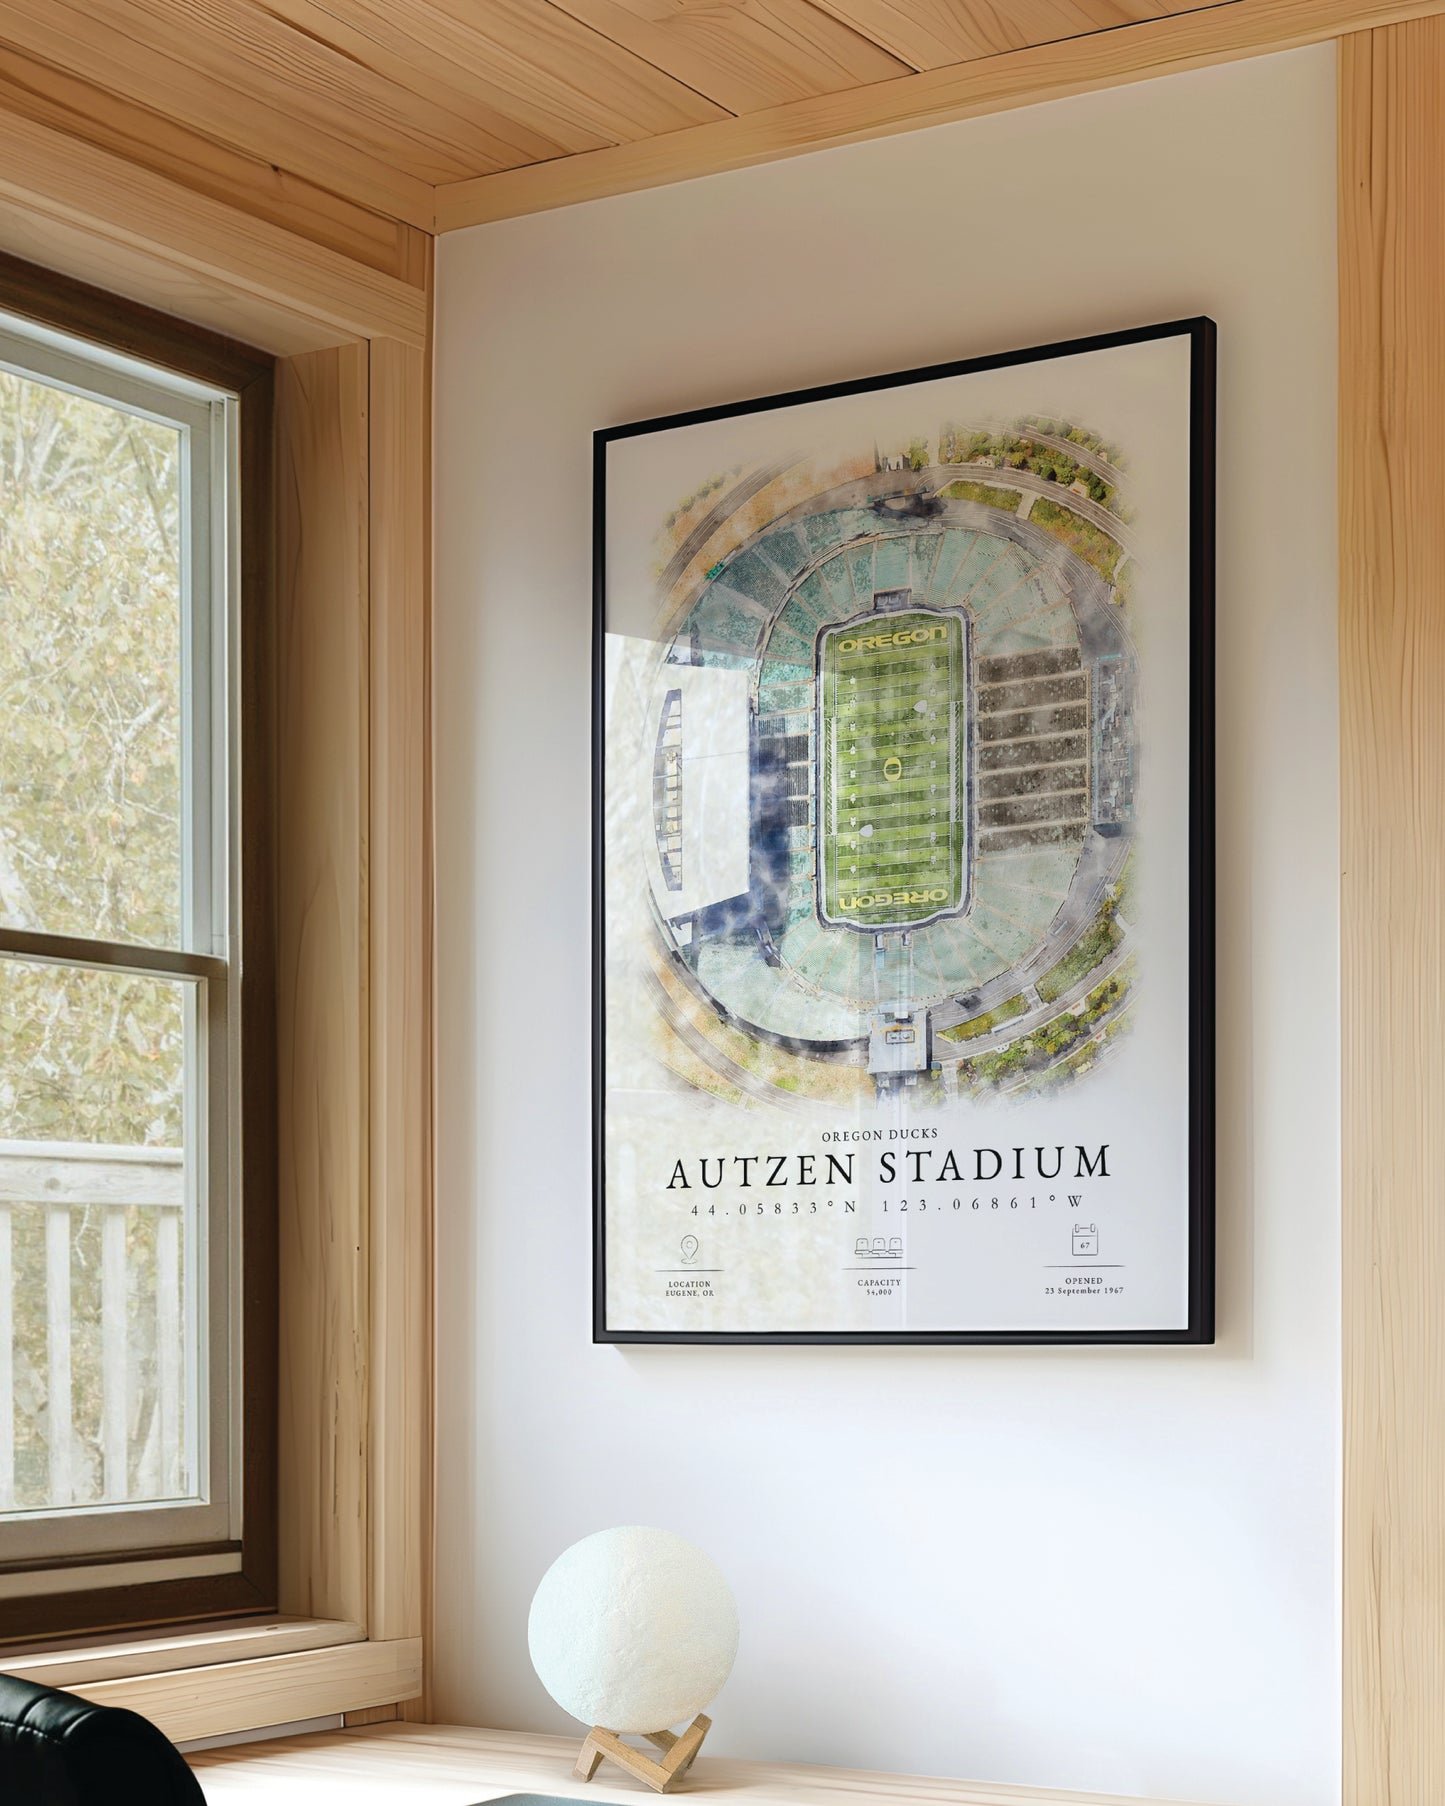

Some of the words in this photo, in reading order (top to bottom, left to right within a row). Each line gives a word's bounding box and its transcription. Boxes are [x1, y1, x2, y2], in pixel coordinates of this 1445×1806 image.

[838, 626, 948, 653] OREGON
[821, 1130, 883, 1143] OREGON
[889, 1128, 938, 1140] DUCKS
[666, 1153, 856, 1190] AUTZEN
[879, 1144, 1111, 1184] STADIUM
[1080, 1242, 1090, 1250] 67
[668, 1280, 712, 1289] LOCATION
[857, 1279, 901, 1288] CAPACITY
[1065, 1277, 1103, 1286] OPENED
[665, 1289, 700, 1298] EUGENE,
[702, 1289, 715, 1297] OR
[866, 1288, 892, 1297] 54,000
[1045, 1287, 1055, 1295] 23
[1057, 1286, 1102, 1297] September
[1104, 1286, 1124, 1295] 1967
